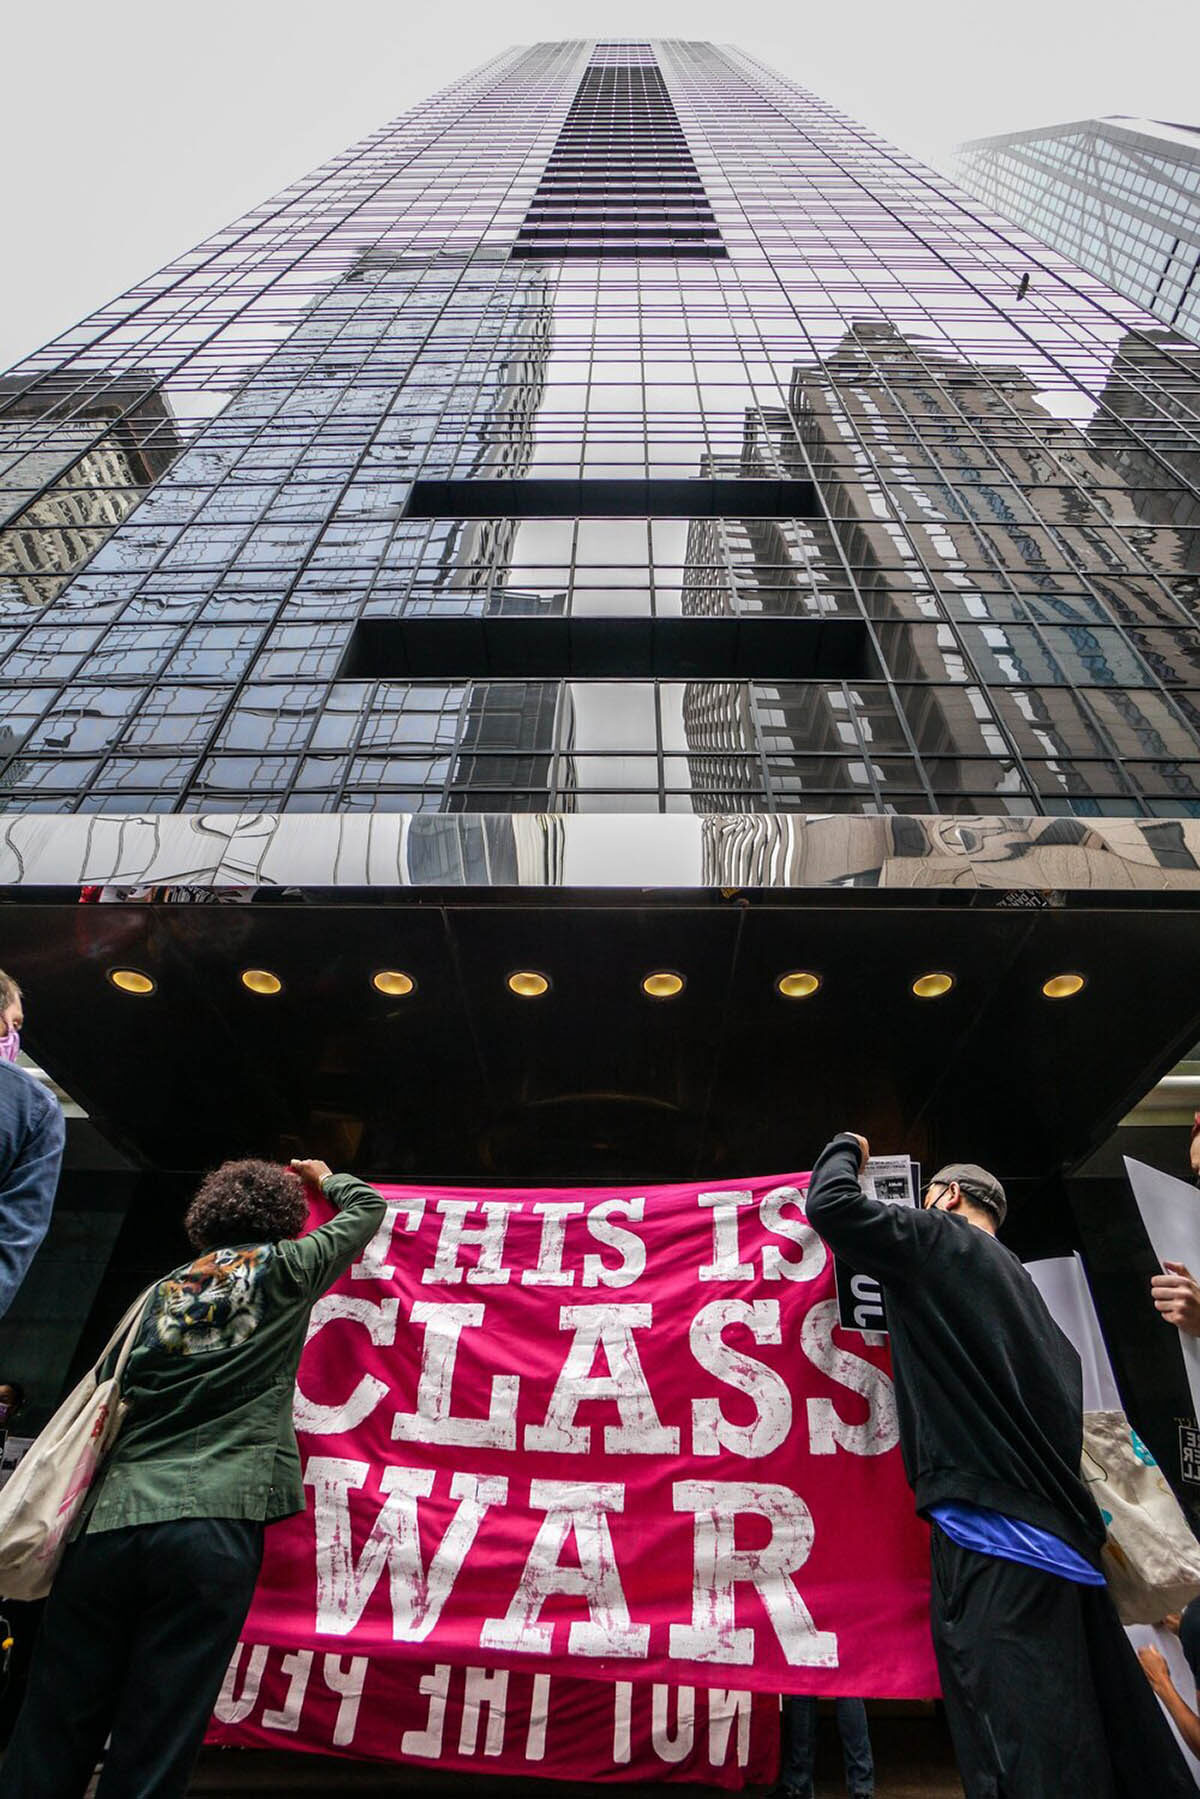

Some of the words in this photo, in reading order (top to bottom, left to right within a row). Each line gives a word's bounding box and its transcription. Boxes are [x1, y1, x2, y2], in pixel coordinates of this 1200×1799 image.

[351, 1197, 647, 1288] THIS
[698, 1186, 827, 1282] IS
[293, 1295, 900, 1459] CLASS
[303, 1456, 838, 1669] WAR
